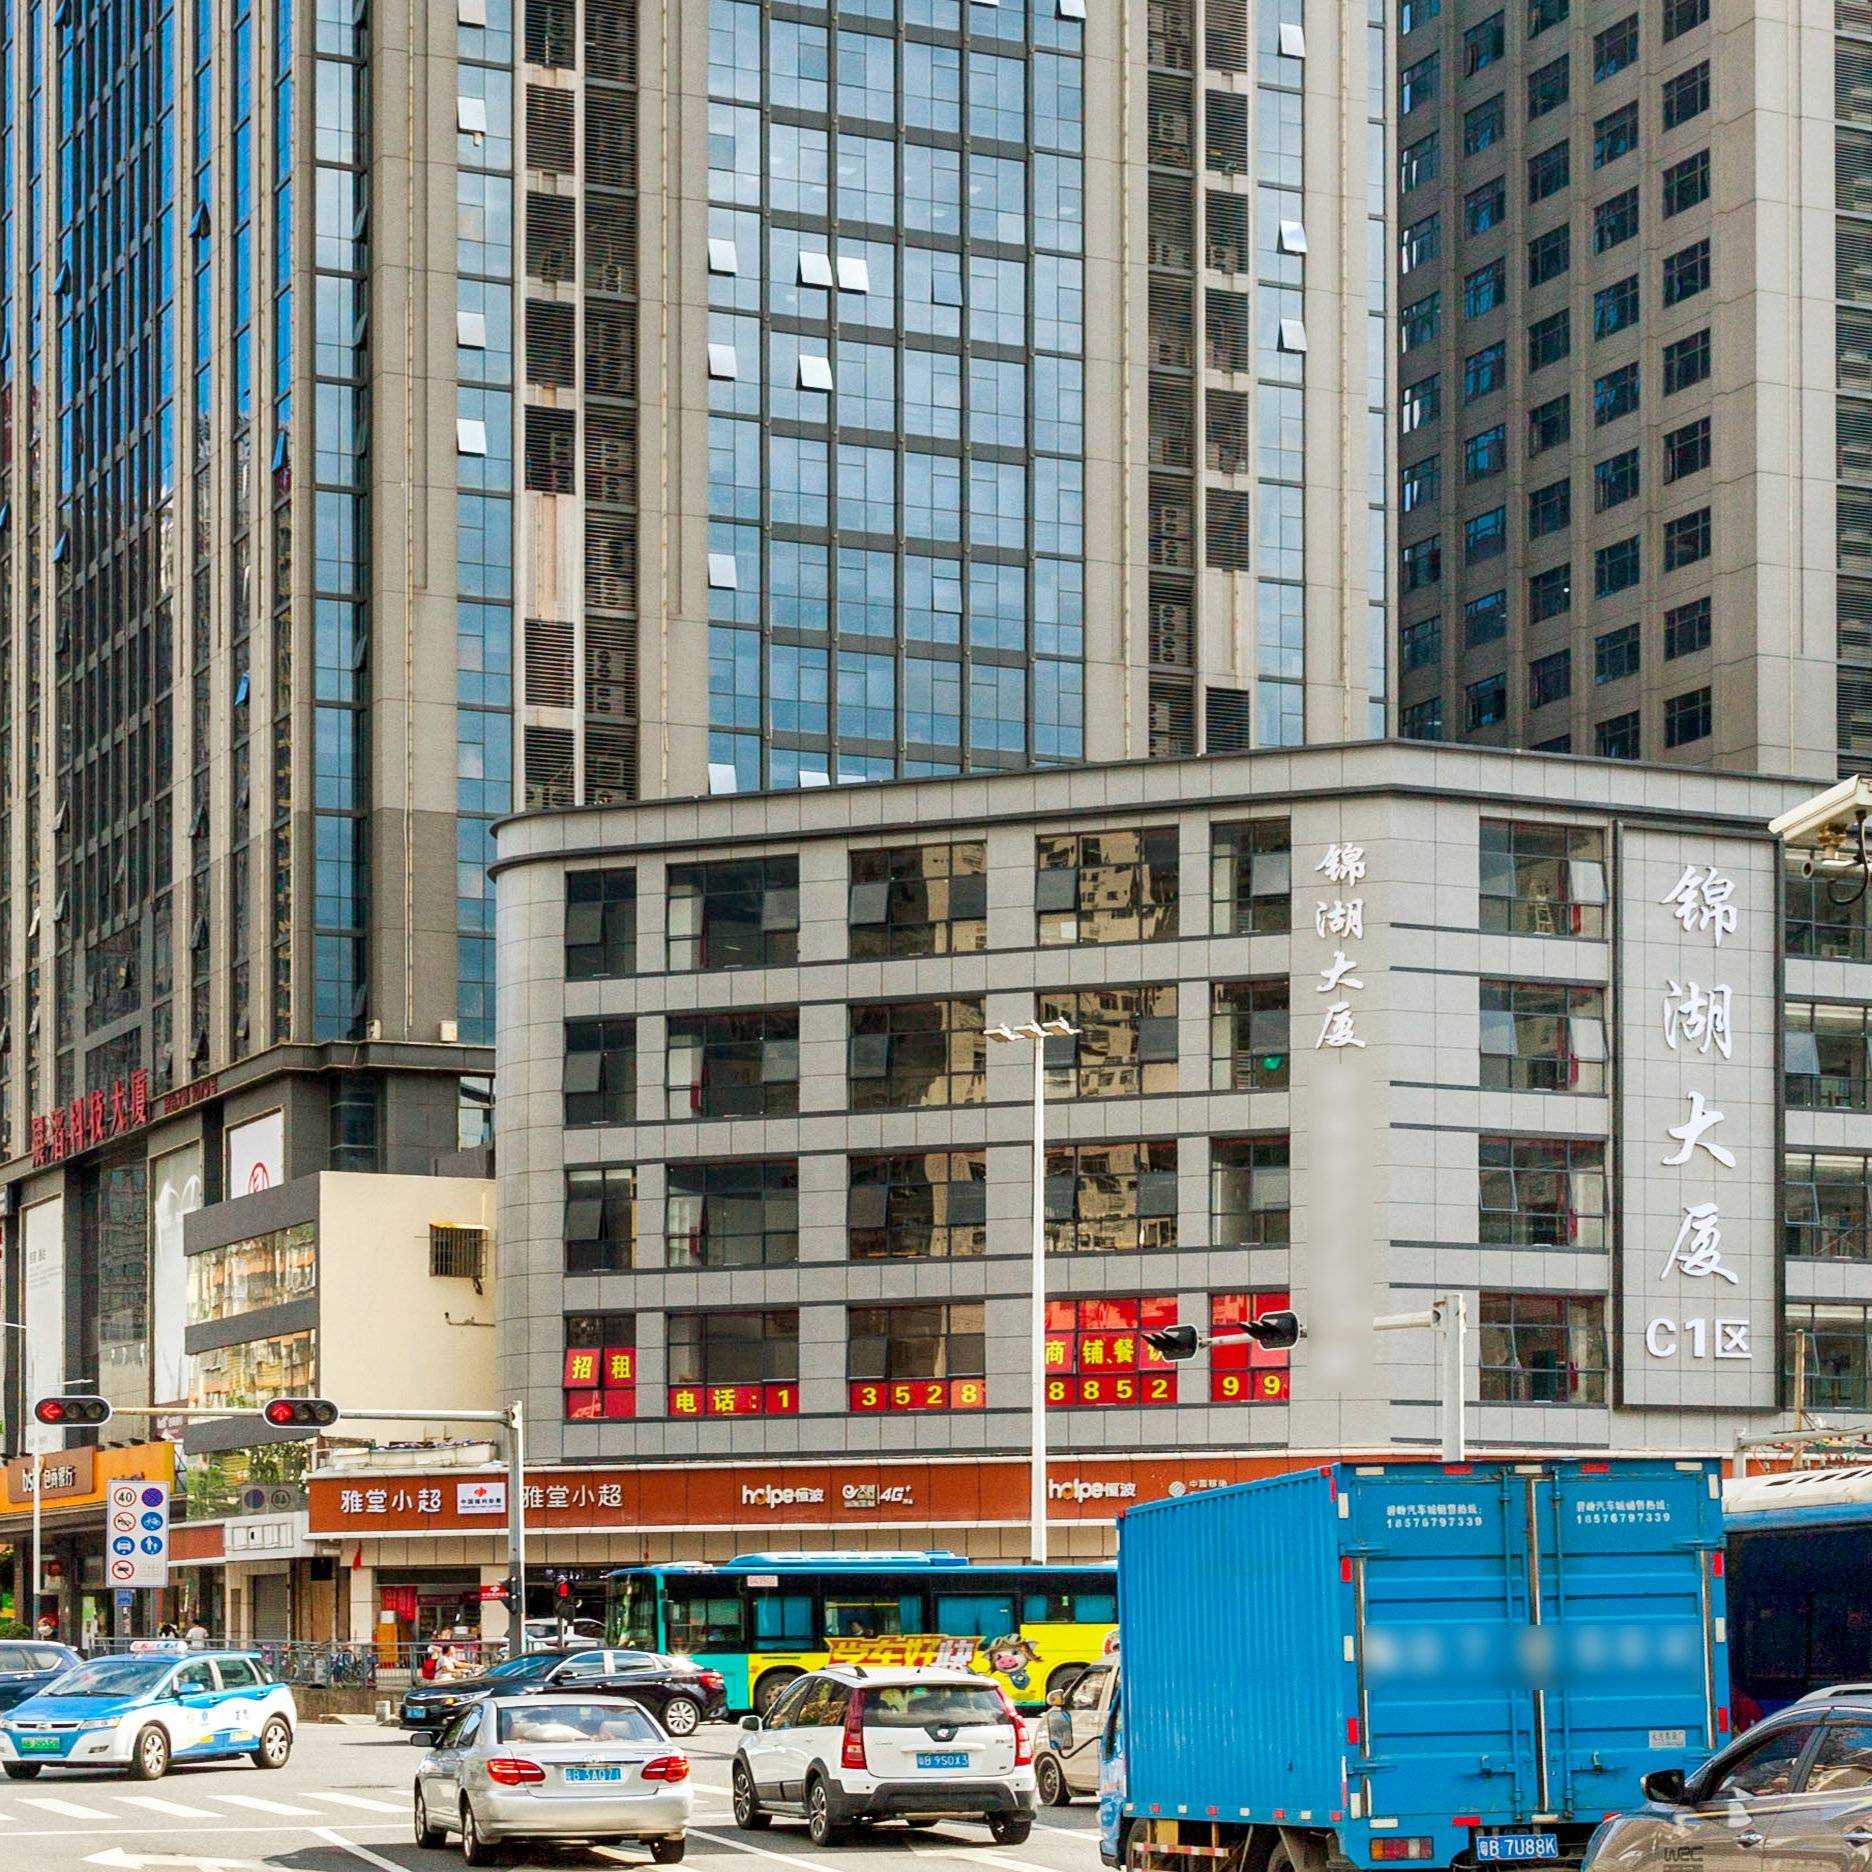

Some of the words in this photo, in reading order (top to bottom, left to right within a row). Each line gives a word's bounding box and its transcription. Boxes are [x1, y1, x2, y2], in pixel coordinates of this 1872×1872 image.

[1315, 842, 1367, 1050] 锦湖大厦
[1658, 863, 1740, 1286] 锦湖大厦
[1645, 1317, 1753, 1360] C1区
[572, 1354, 632, 1381] 招租
[118, 1492, 133, 1502] 40
[340, 1488, 442, 1514] 雅堂小超
